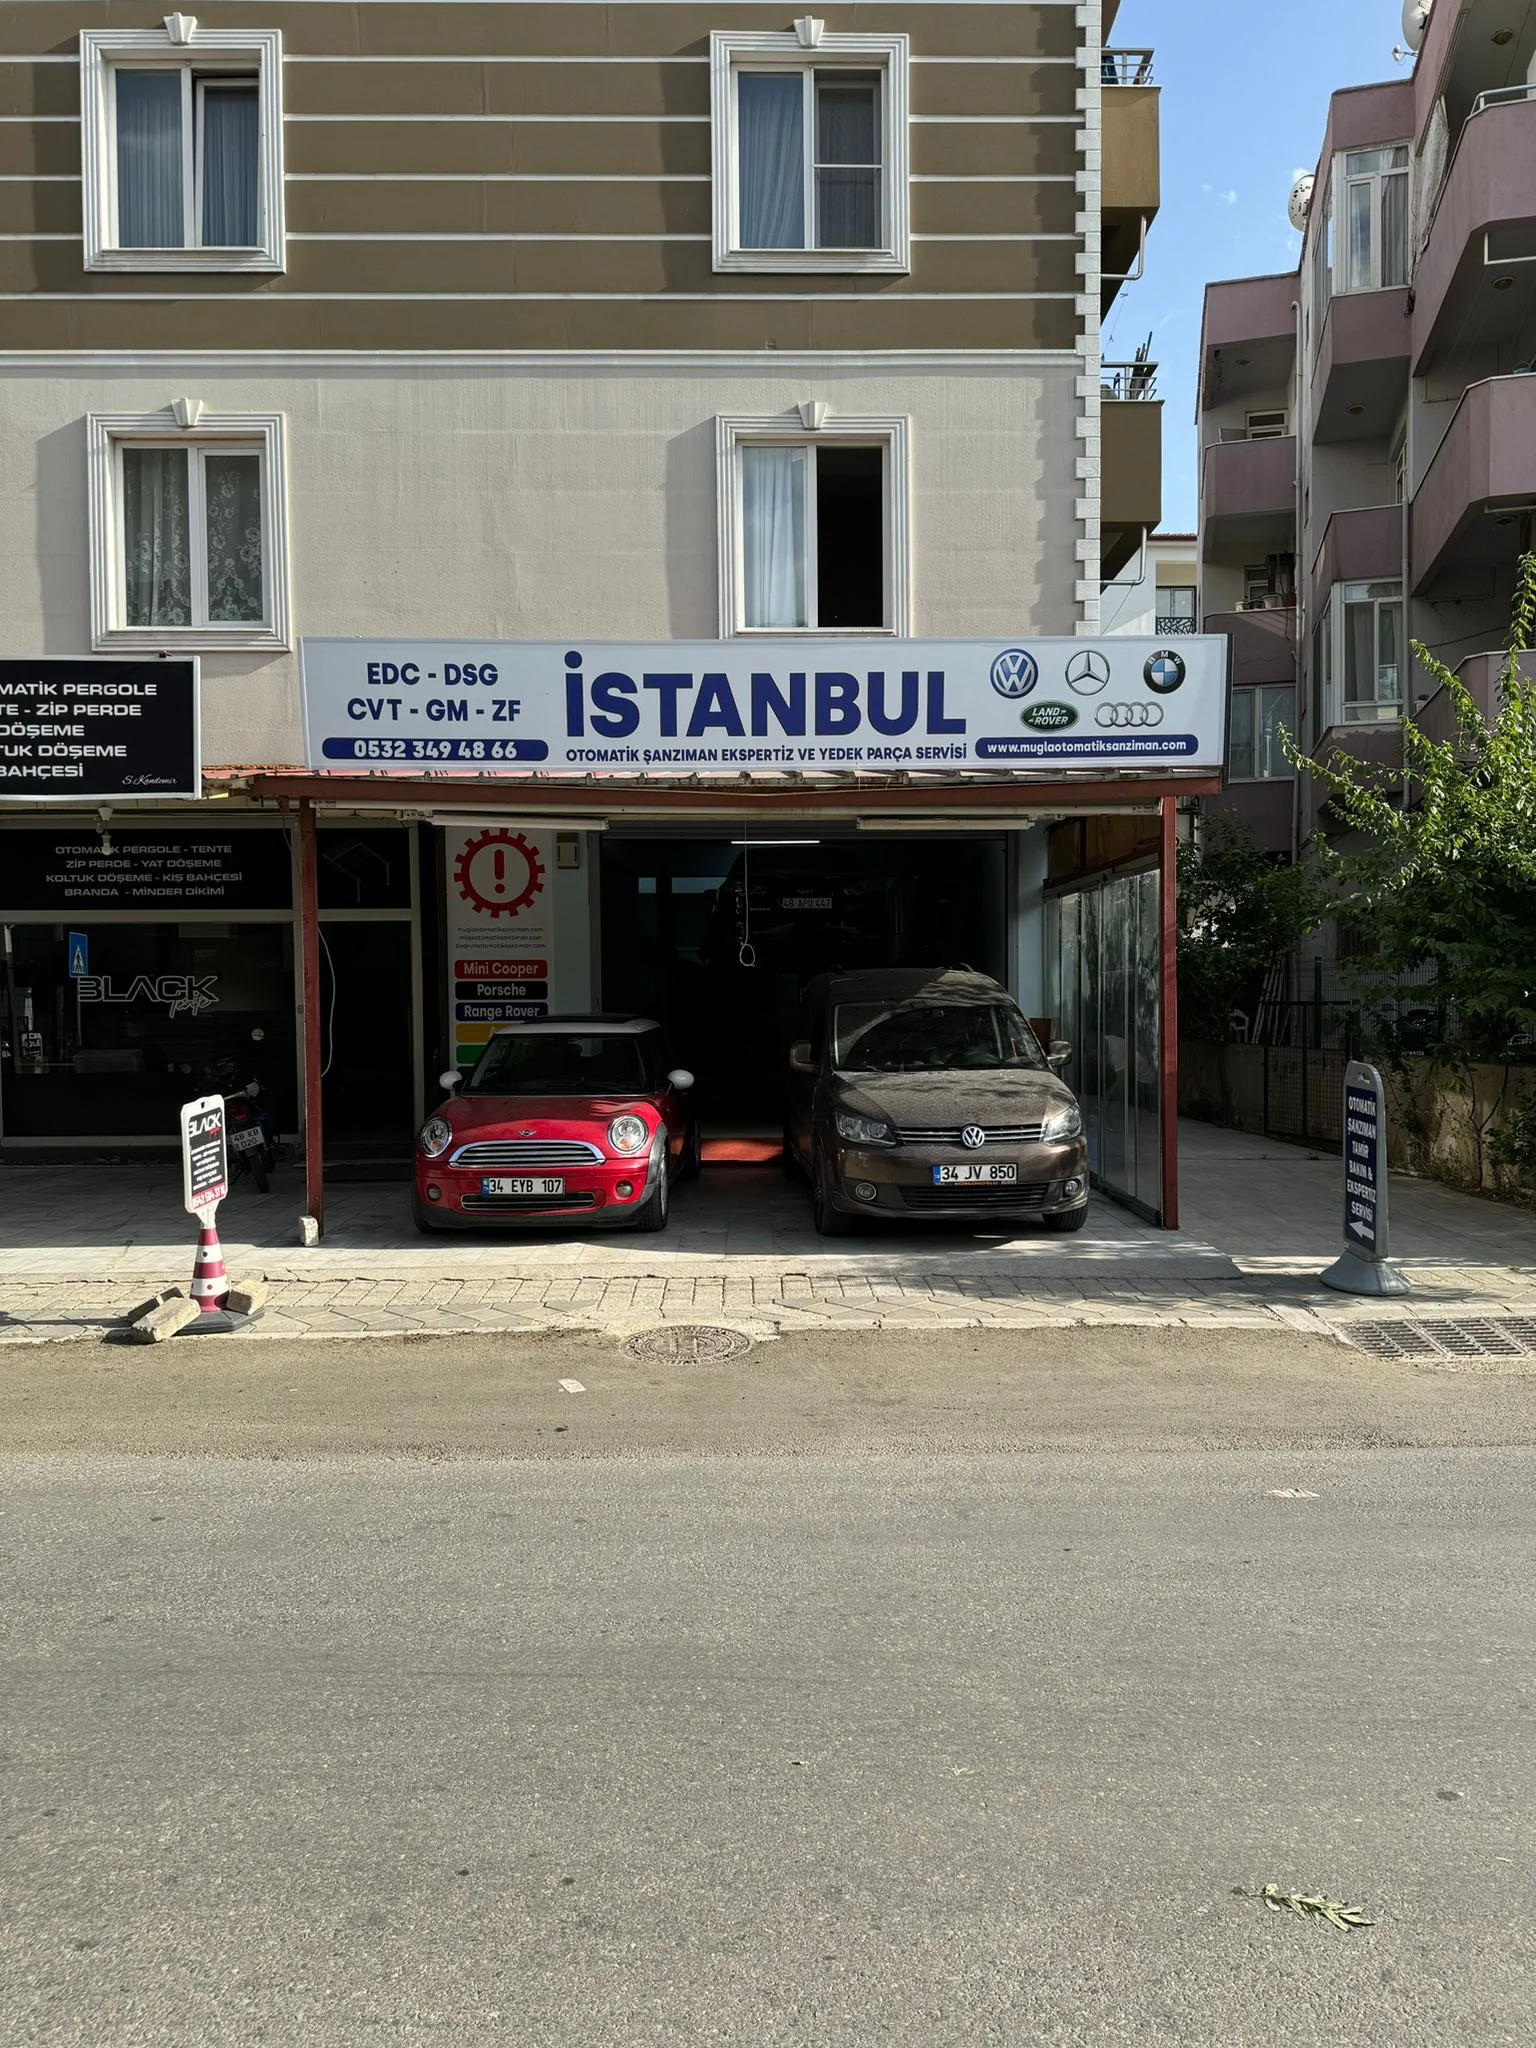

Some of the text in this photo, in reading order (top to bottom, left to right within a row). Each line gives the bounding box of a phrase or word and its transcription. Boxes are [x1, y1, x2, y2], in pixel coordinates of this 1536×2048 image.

[367, 662, 421, 686] EDC
[444, 663, 499, 686] DSG
[63, 683, 158, 696] PERGOLE
[564, 651, 967, 738] İSTANBUL
[36, 701, 69, 716] ZİP
[73, 704, 142, 716] PERDE
[347, 697, 402, 721] CVT
[425, 699, 468, 722] GM
[492, 699, 521, 722] ZF
[1032, 707, 1060, 716] LAND
[1034, 716, 1069, 725] ROVER
[0, 721, 85, 739] DÖŞEME
[38, 742, 127, 760] DÖŞEME
[354, 739, 518, 759] 0532 349 48 66
[566, 742, 967, 765] OTOMATİK ŞANZIMAN EKSPERTİZ VE YEDEK PARÇA SERVİSİ
[987, 740, 1187, 755] www.muglaotomatiksanziman.com
[122, 845, 182, 854] PERGOLE
[191, 845, 232, 853] TENTE
[65, 858, 86, 869] ZİP
[88, 860, 131, 868] PERDE
[141, 860, 165, 868] YAT
[167, 857, 222, 869] DÖŞEME
[46, 874, 95, 883] KOLTUK
[97, 872, 153, 884] DÖŞEME
[163, 873, 184, 883] KIŞ
[186, 871, 242, 883] BAHÇESİ
[64, 888, 119, 896] BRANDA
[132, 886, 183, 896] MİNDER
[185, 886, 225, 895] DİKİMİ
[464, 962, 539, 977] Mini Cooper
[78, 975, 220, 1002] BLACK
[477, 983, 526, 996] Porsche
[464, 1005, 539, 1020] Range Rover
[1348, 1096, 1377, 1117] OTOMATİK
[188, 1111, 222, 1138] BLACK
[1347, 1118, 1377, 1140] ŞANZIMAN
[1352, 1140, 1369, 1159] TAMİR
[942, 1165, 1015, 1180] 34 JV 850
[1349, 1160, 1373, 1181] BAKIM &
[489, 1179, 561, 1192] 34 EYB 107
[1347, 1179, 1376, 1203] EKSPERTİZ
[1351, 1201, 1373, 1223] SERVİSİ
